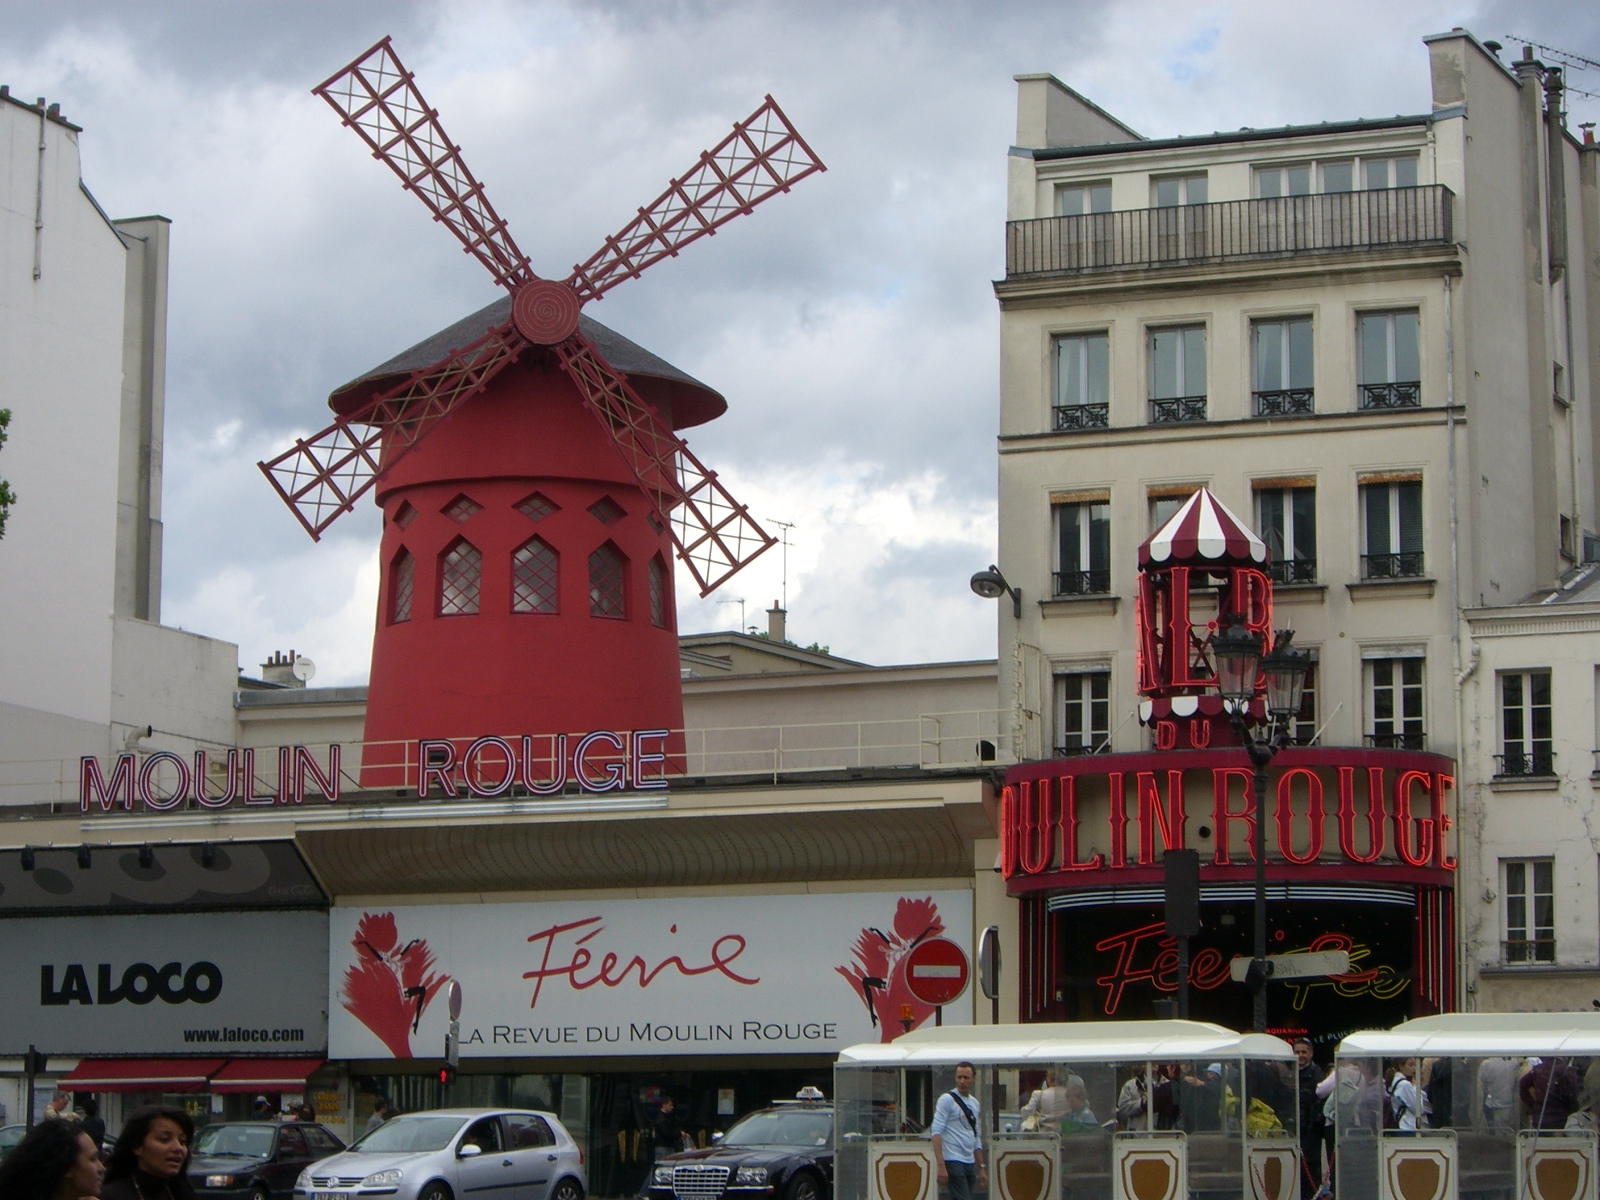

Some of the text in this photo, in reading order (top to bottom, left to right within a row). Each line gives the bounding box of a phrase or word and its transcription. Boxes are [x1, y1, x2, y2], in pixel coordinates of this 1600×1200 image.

[1157, 720, 1210, 750] DU
[80, 730, 669, 812] MOULIN ROUGE
[1210, 766, 1456, 870] ROUGE
[523, 916, 760, 1009] Féerie
[184, 1027, 304, 1042] www.laloco.com
[493, 1025, 579, 1044] REVUE
[586, 1027, 621, 1043] DU
[629, 1023, 732, 1041] MOULIN
[743, 1021, 838, 1040] ROUGE
